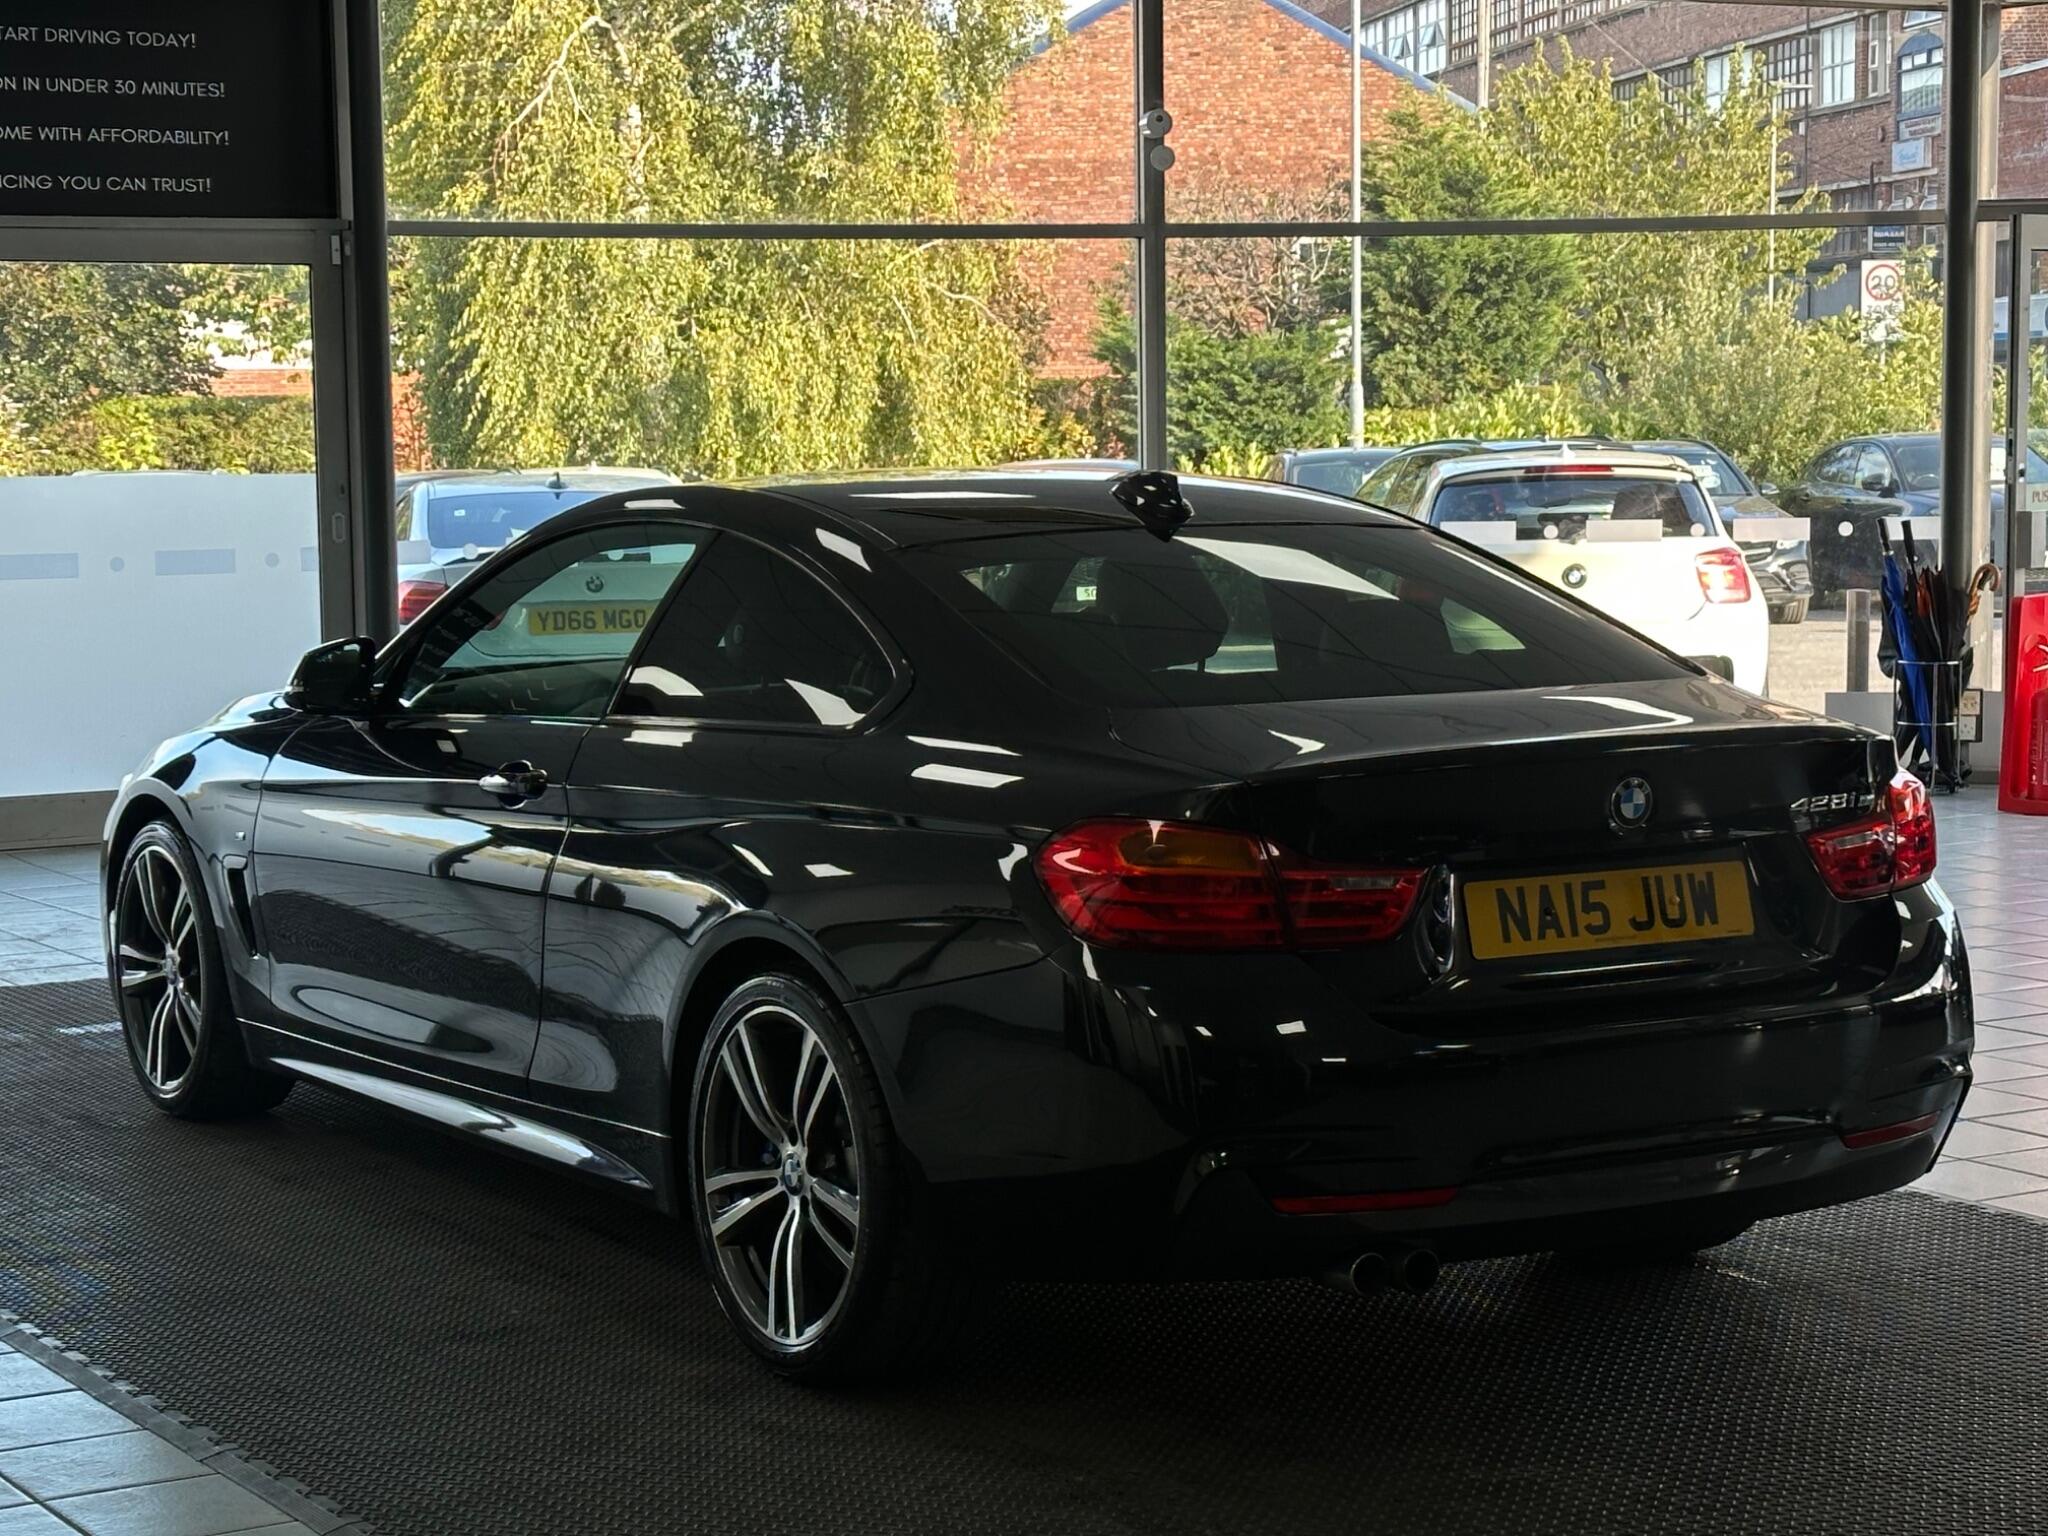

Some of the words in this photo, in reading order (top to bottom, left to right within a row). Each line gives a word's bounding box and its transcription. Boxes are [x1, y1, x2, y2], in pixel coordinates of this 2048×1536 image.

[44, 27, 121, 45] DRIVING
[126, 31, 196, 49] TODAY!
[0, 76, 17, 91] N
[22, 76, 40, 92] IN
[45, 77, 109, 94] UNDER
[114, 79, 136, 95] 30
[141, 81, 225, 98] MINUTES!
[0, 125, 33, 141] ME
[38, 126, 82, 142] WITH
[87, 127, 229, 146] AFFORDABILITY!
[57, 175, 101, 191] YOU
[106, 176, 147, 192] CAN
[151, 177, 212, 194] TRUST!
[1871, 274, 1897, 291] 20
[537, 609, 597, 632] YD66
[602, 608, 648, 630] MGO
[1790, 791, 1857, 813] 428i
[1495, 878, 1612, 944] NA15
[1628, 871, 1720, 932] JUW
